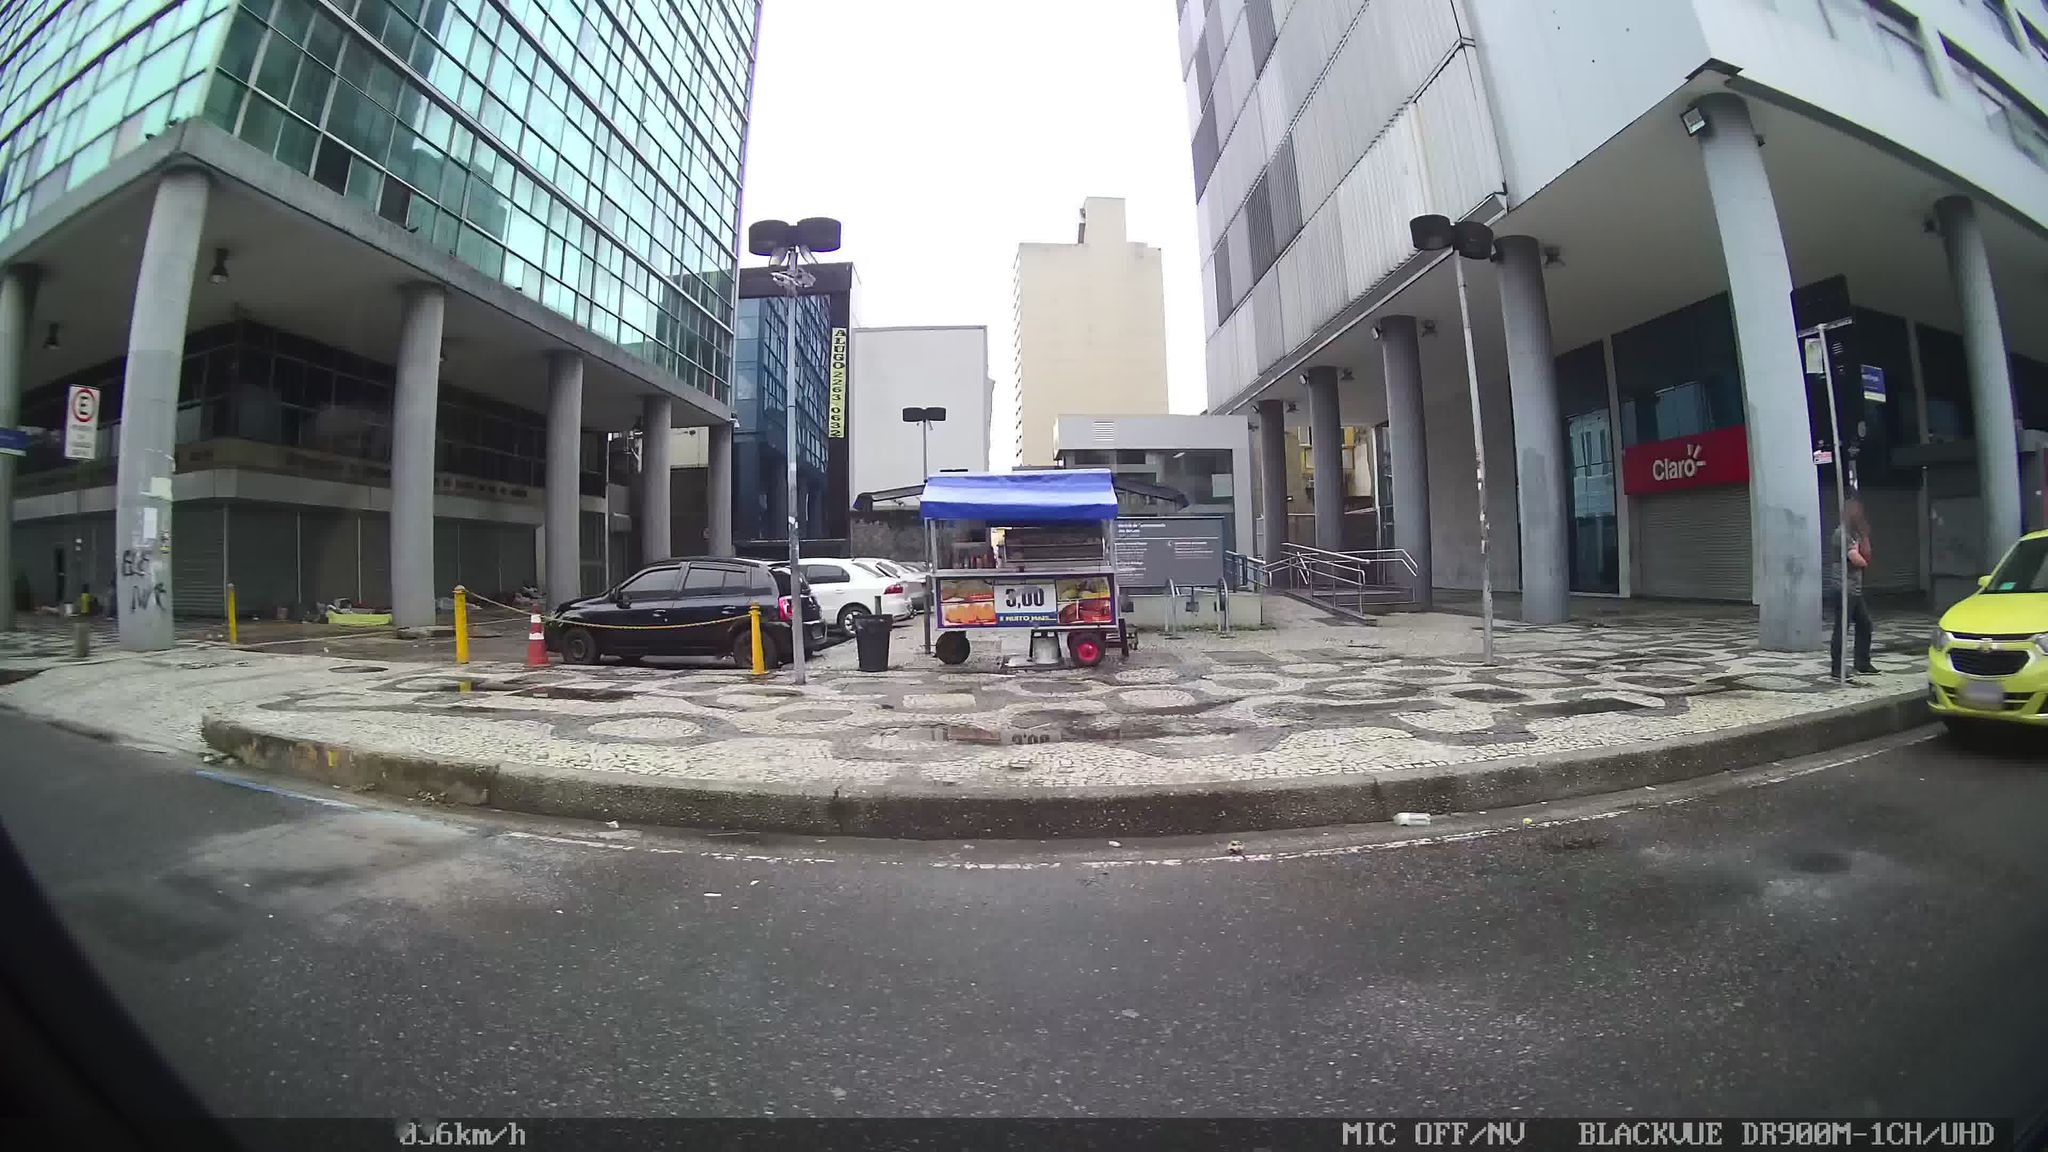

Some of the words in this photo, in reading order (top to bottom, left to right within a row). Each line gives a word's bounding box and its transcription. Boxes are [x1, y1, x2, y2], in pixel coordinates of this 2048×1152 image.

[833, 329, 847, 370] ALUGO
[831, 371, 844, 401] 2263
[830, 406, 842, 438] 0632
[1652, 457, 1697, 481] Claro
[1005, 588, 1045, 609] 3,00
